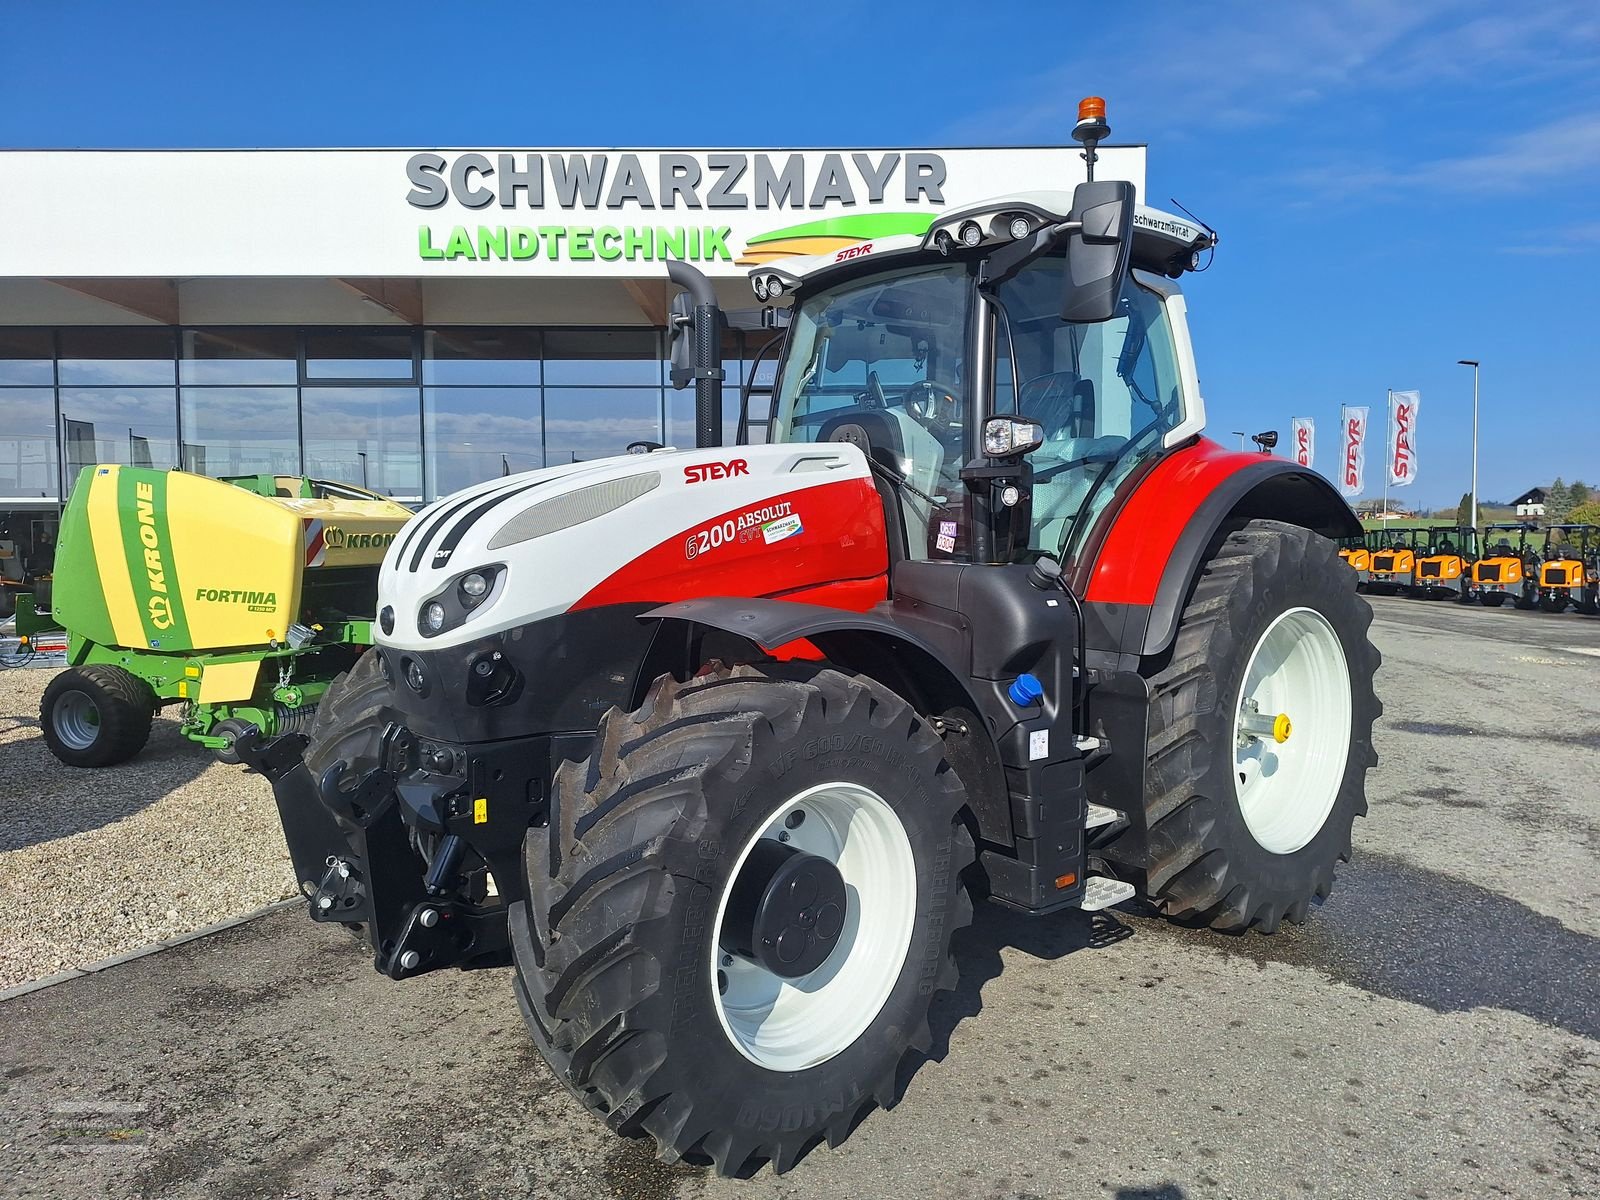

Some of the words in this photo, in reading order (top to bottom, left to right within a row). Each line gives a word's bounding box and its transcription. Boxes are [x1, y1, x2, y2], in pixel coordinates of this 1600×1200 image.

[405, 152, 947, 211] SCHWARZMAYR
[417, 225, 733, 262] LANDTECHNIK
[1134, 213, 1189, 238] schwarzmayr.at
[835, 243, 873, 262] STEYR
[1297, 428, 1308, 467] EYR
[1345, 418, 1361, 488] STEYR
[1394, 403, 1410, 478] STEYR
[683, 458, 750, 484] STEYR
[136, 481, 168, 593] KRONE
[346, 533, 398, 548] KRON
[685, 520, 736, 560] 6200
[736, 502, 792, 531] ABSOLUT
[195, 588, 277, 605] FORTIMA
[918, 836, 953, 996] TRELLEBORG
